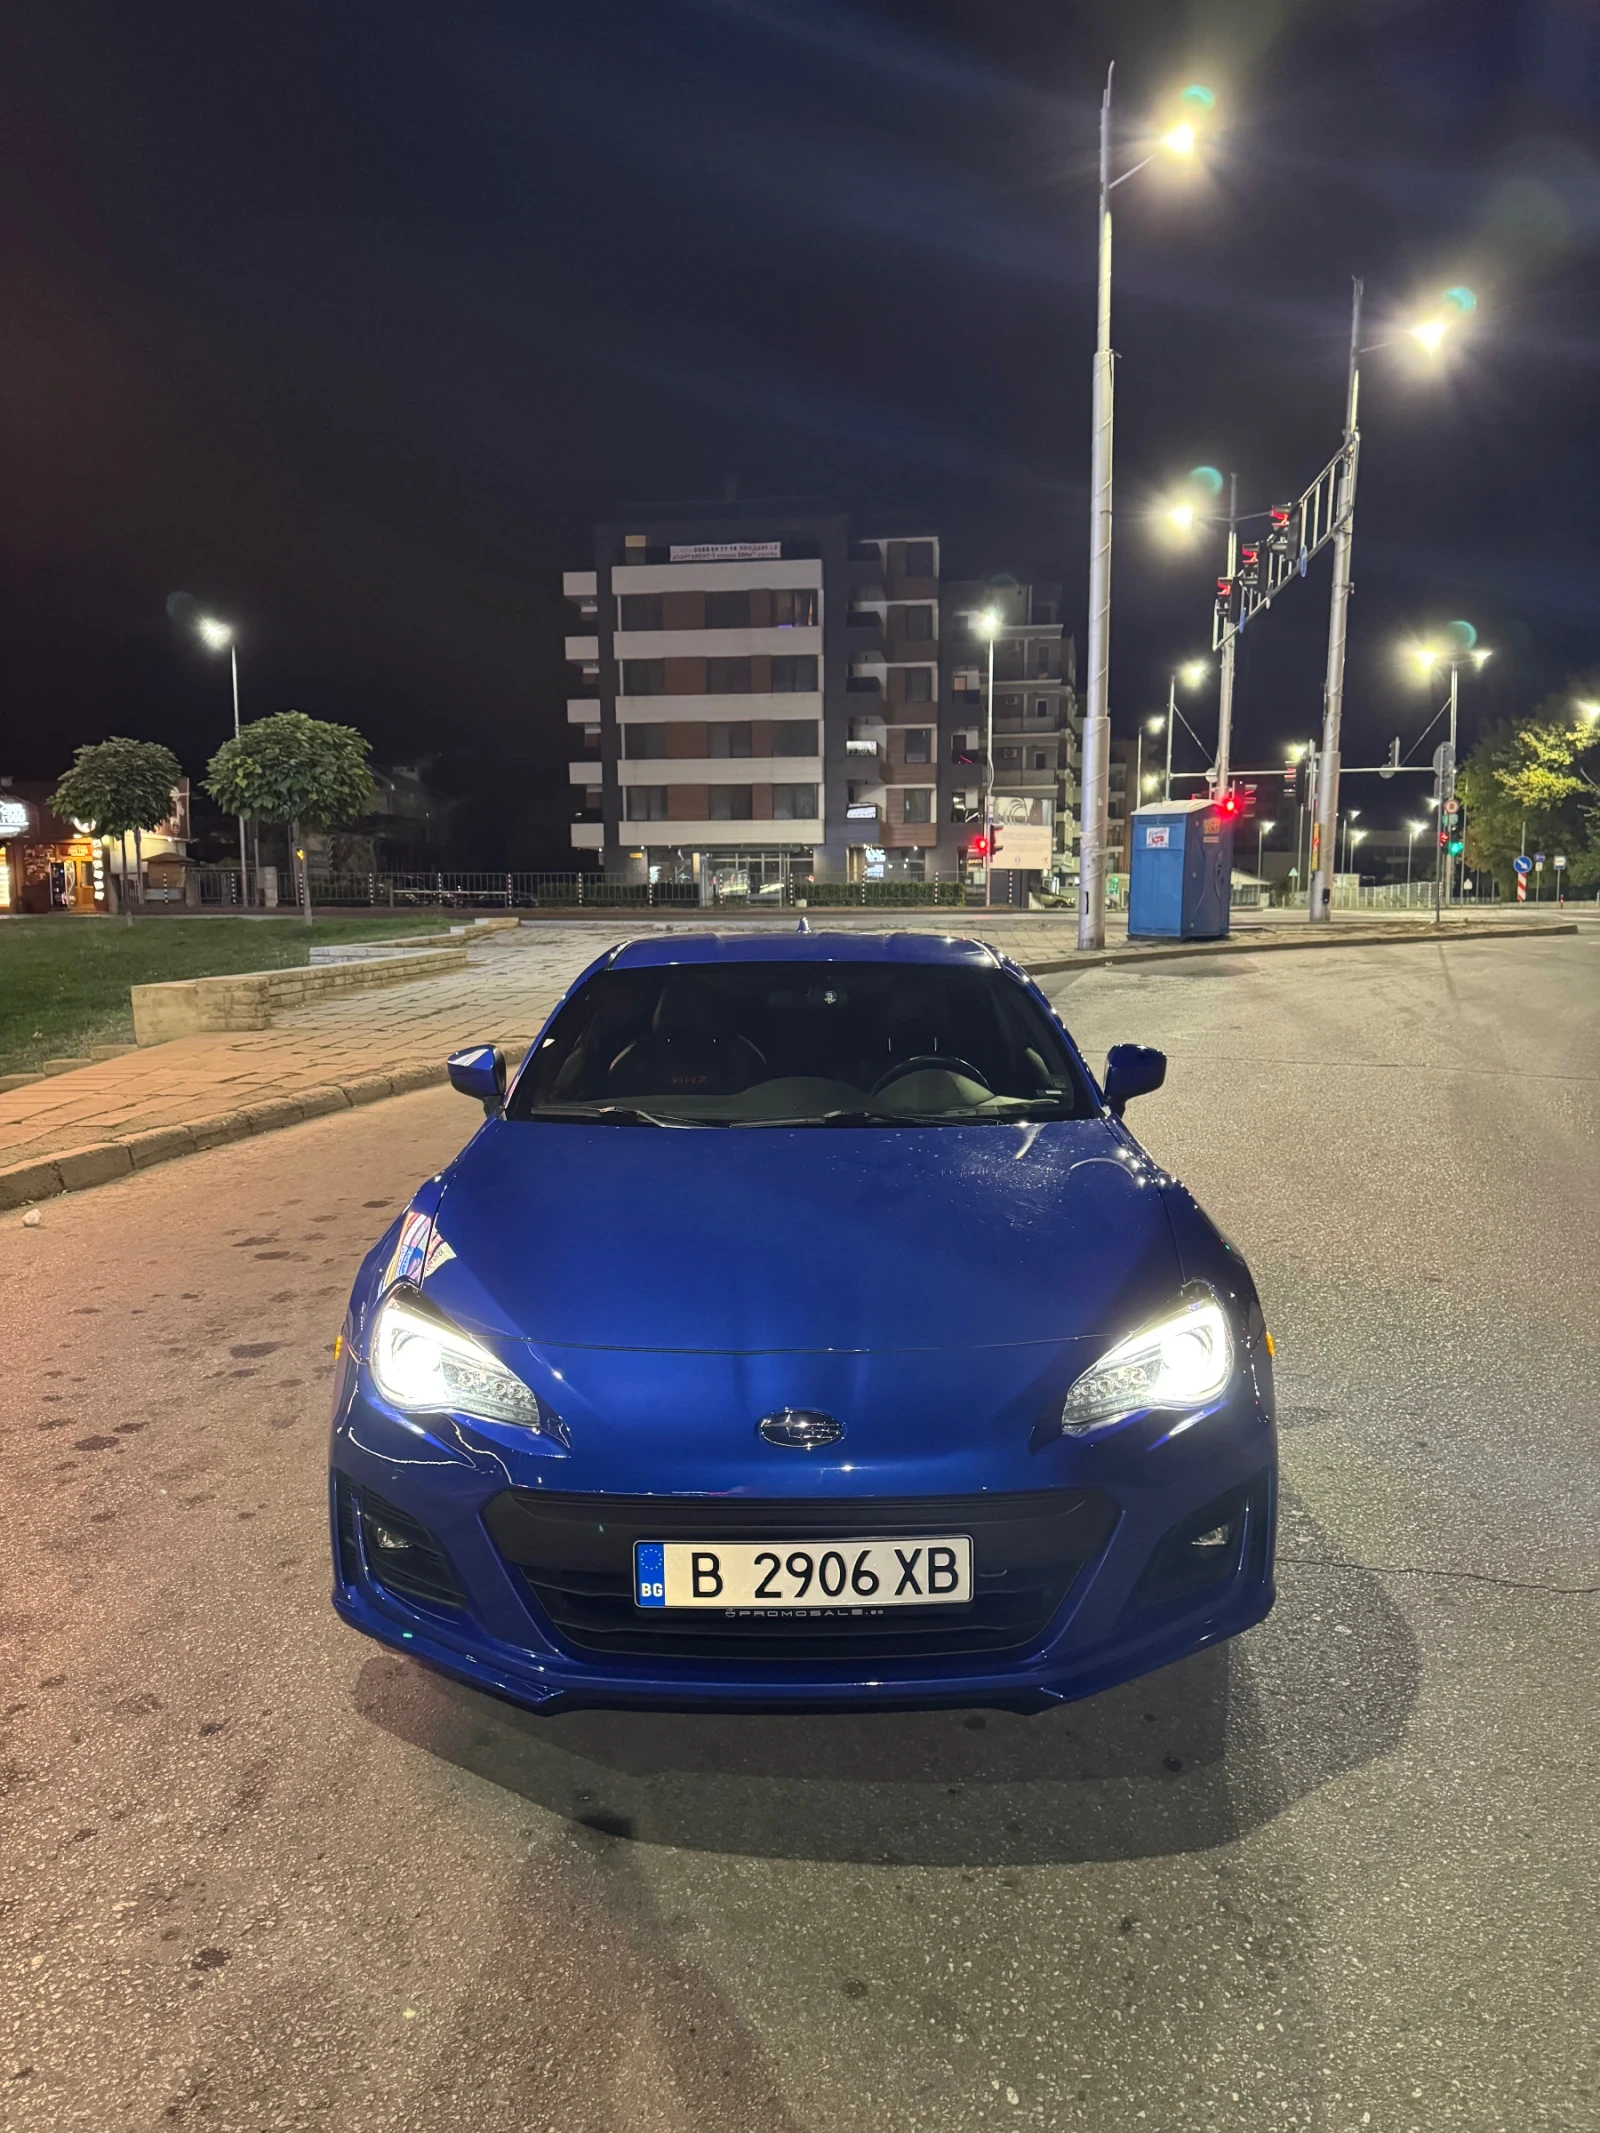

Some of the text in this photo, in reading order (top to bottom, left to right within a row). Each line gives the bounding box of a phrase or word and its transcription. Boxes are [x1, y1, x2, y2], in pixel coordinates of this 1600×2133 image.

[641, 1547, 959, 1598] BG B 2906 XB
